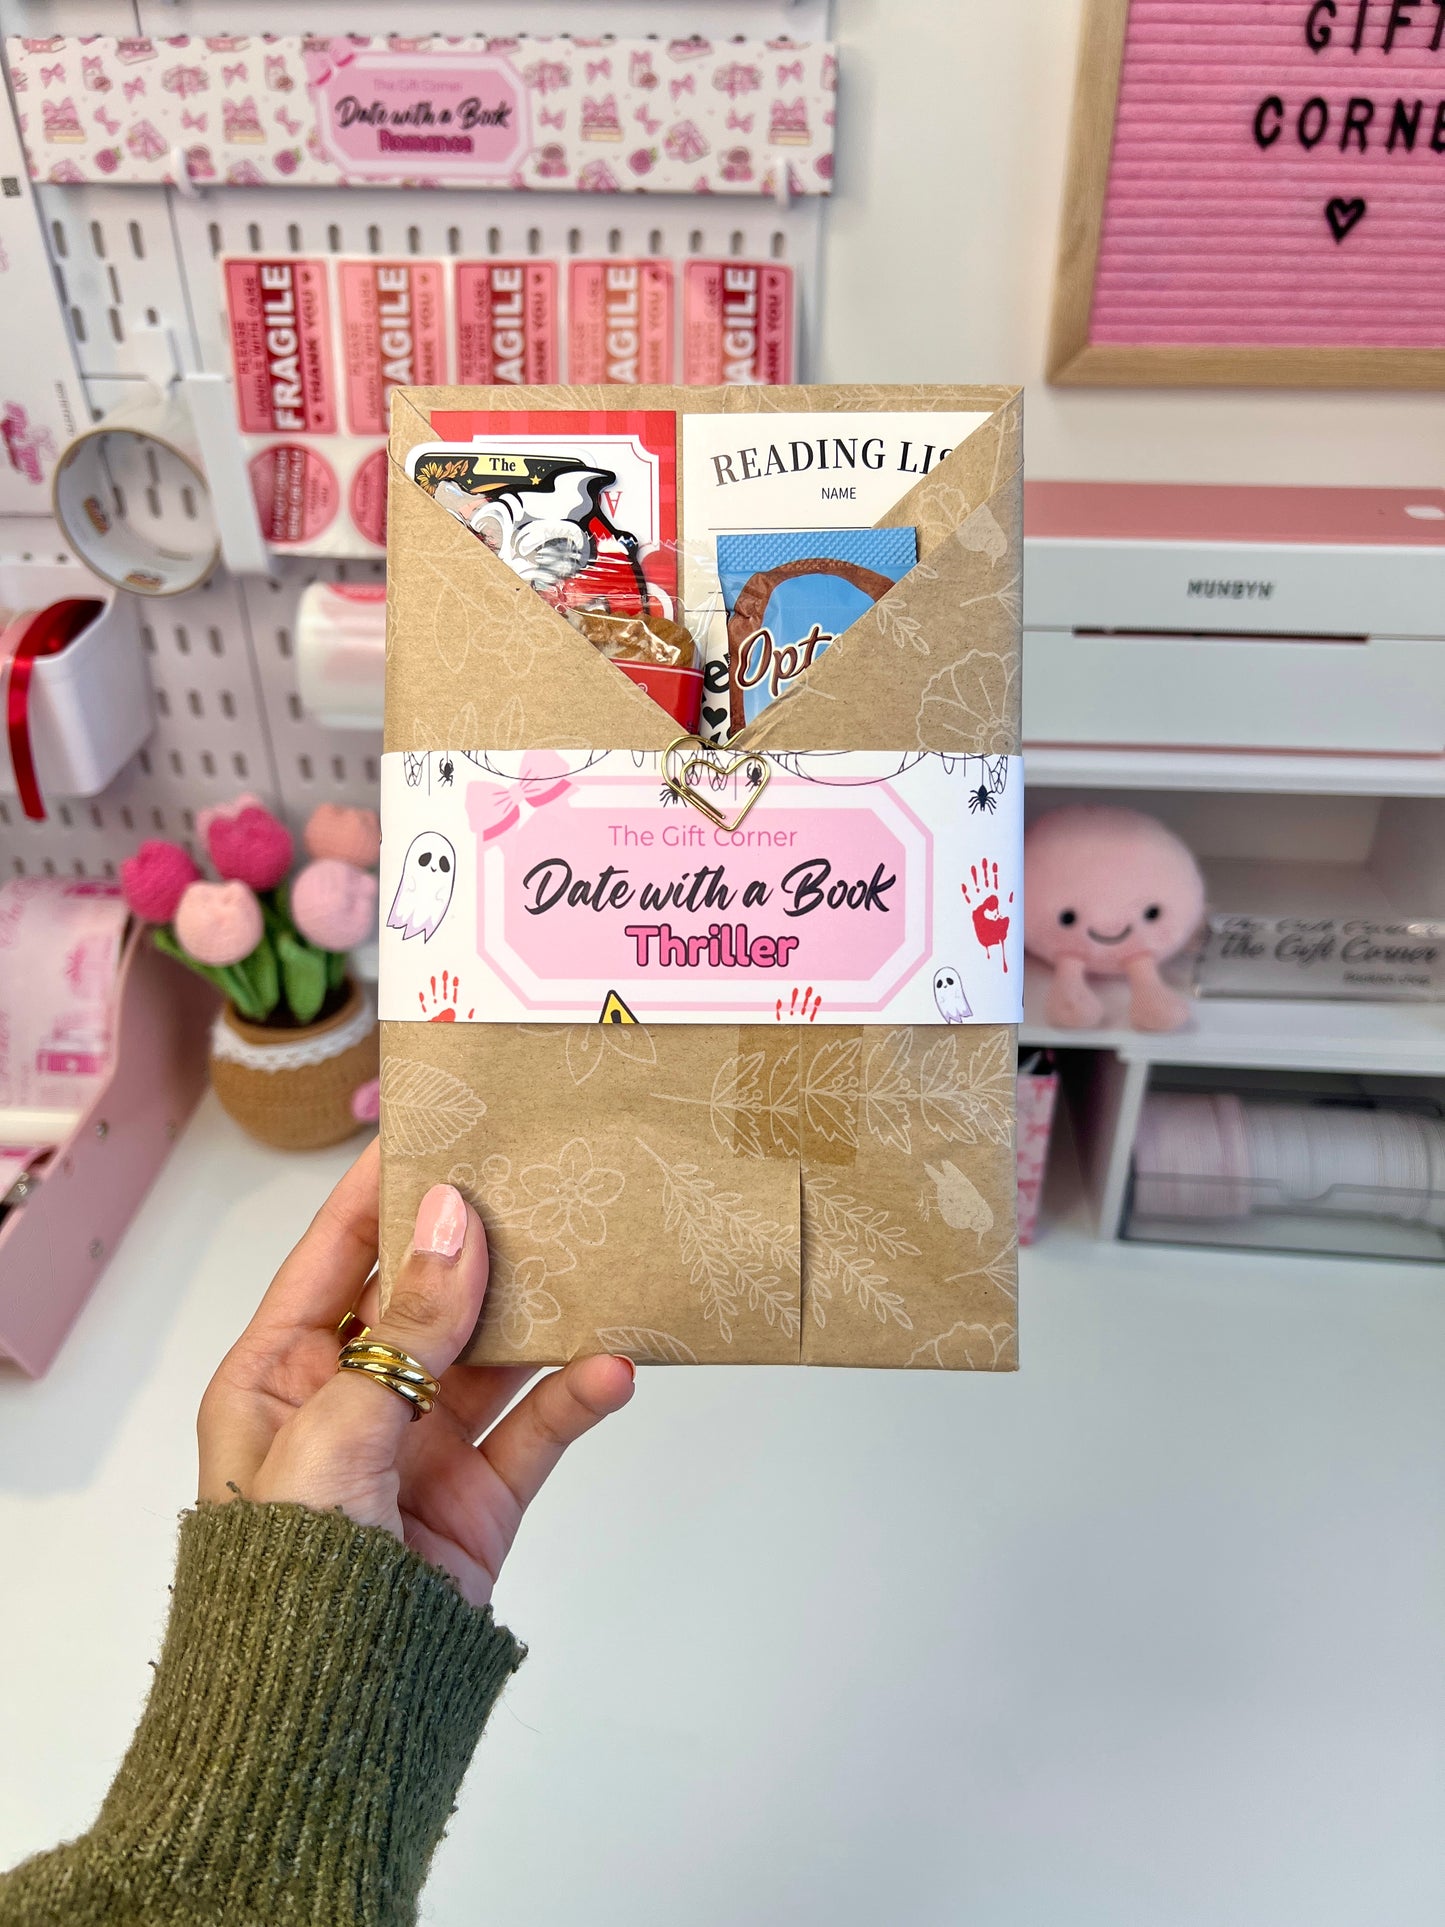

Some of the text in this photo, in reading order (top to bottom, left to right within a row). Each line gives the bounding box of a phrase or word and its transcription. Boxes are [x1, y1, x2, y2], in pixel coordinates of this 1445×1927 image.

[335, 95, 512, 130] Date with a Book
[377, 129, 474, 152] Romance
[491, 267, 524, 384] AGILE
[533, 292, 547, 330] YOU
[606, 266, 638, 384] AGILE
[723, 268, 757, 384] AGILE
[766, 294, 780, 332] YOU
[261, 264, 305, 430] FRAGILE
[302, 290, 324, 403] THANK YOU
[377, 266, 413, 428] AGILE
[489, 458, 516, 472] The
[709, 438, 887, 487] READING
[821, 487, 857, 500] NAME
[1187, 579, 1274, 600] MUNBYN
[735, 625, 838, 698] Opt
[608, 825, 798, 847] The Gift Corner
[523, 858, 897, 917] Date with a Book
[625, 923, 799, 968] Thriller
